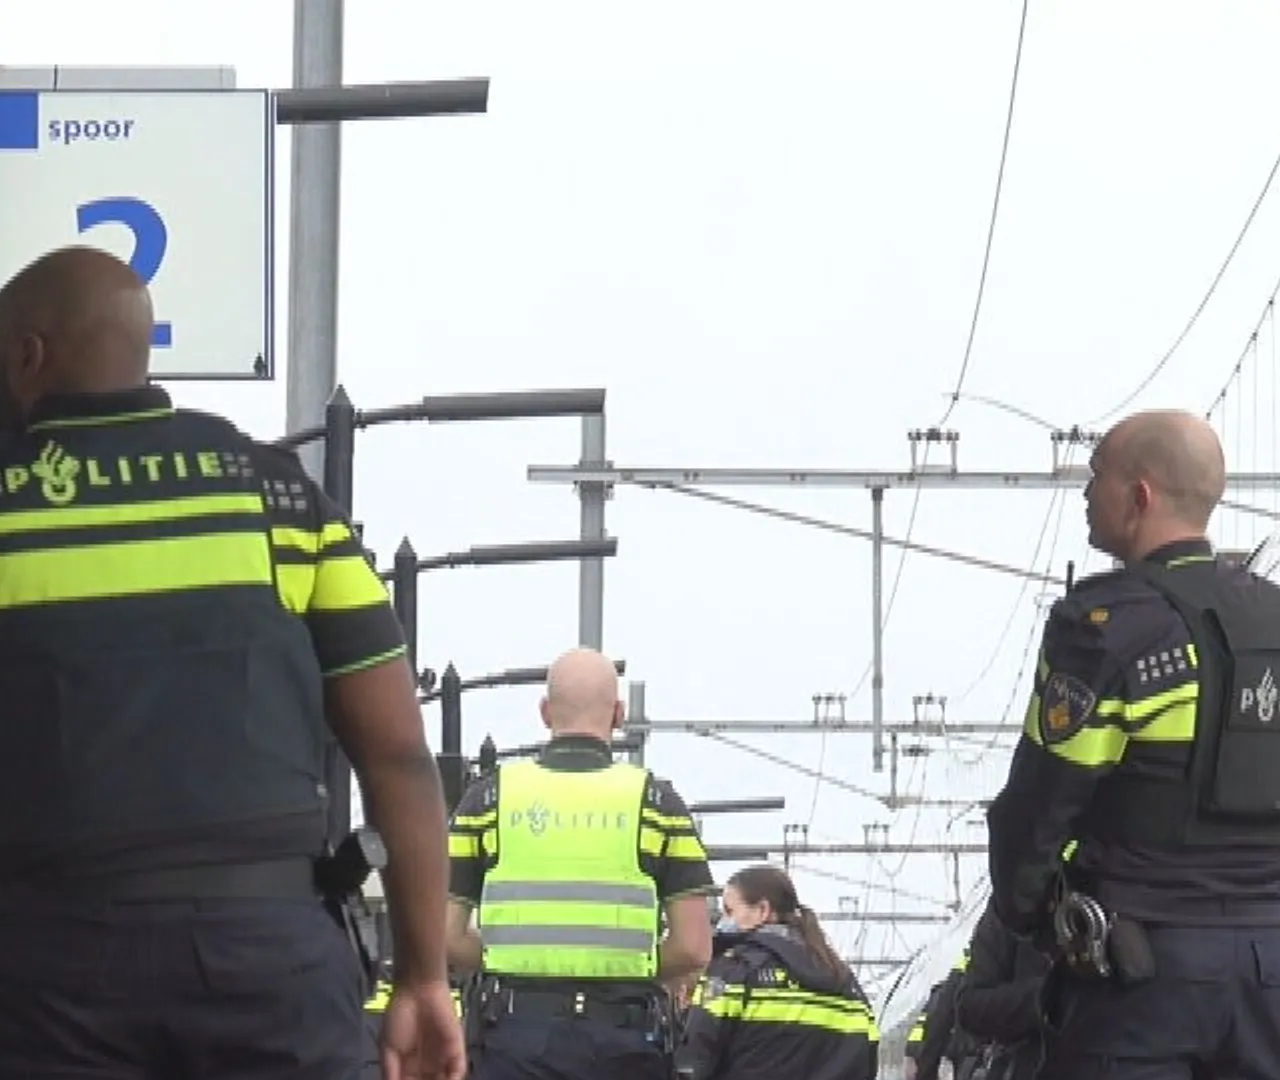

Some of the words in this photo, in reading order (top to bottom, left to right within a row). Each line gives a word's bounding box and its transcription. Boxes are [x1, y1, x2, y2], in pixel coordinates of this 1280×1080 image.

[48, 116, 135, 145] spoor
[4, 441, 225, 505] POLITIE
[511, 803, 628, 835] POLITIE
